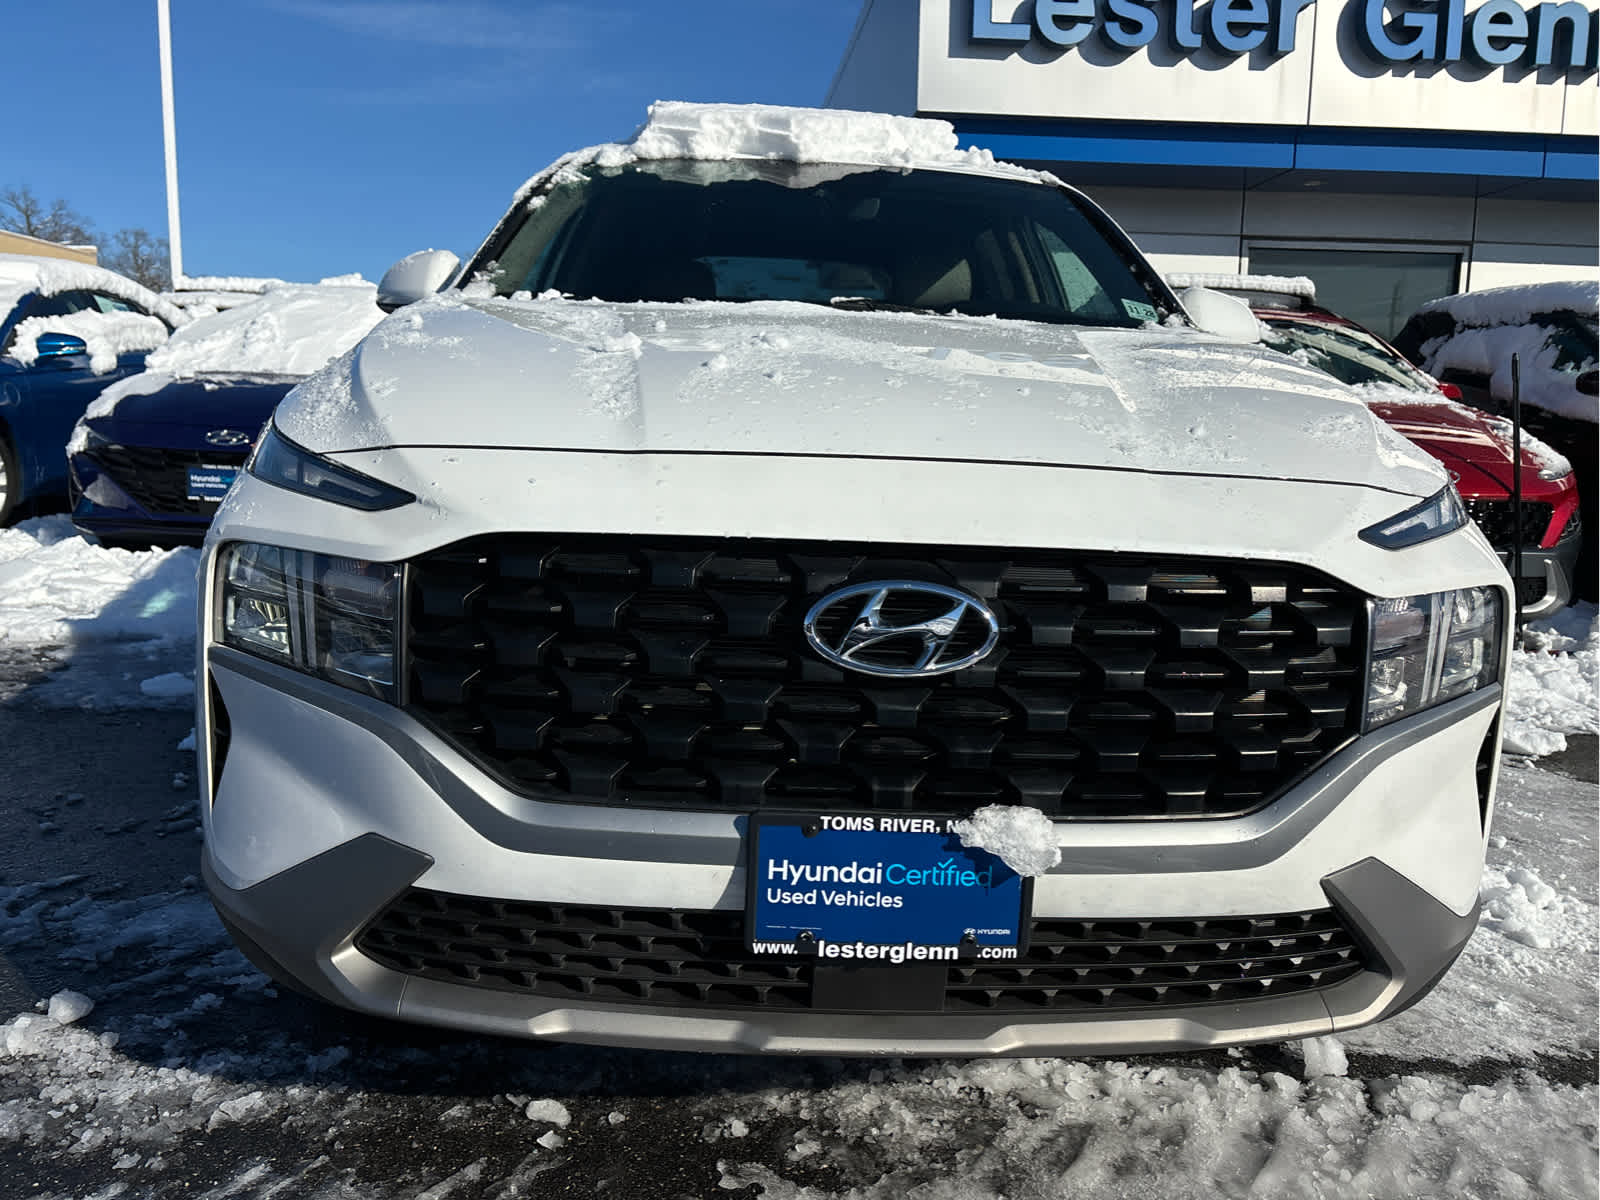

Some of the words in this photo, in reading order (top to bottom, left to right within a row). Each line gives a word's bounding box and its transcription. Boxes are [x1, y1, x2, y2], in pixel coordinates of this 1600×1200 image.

[1366, 0, 1598, 66] Glen
[820, 816, 874, 831] TOMS
[880, 818, 940, 833] RIVER,
[768, 859, 882, 885] Hyundai
[886, 858, 992, 887] Certified
[767, 888, 817, 905] Used
[821, 890, 903, 908] Vehicles
[753, 942, 798, 954] www.
[818, 940, 958, 963] lesterglenn
[977, 947, 1017, 959] .com
